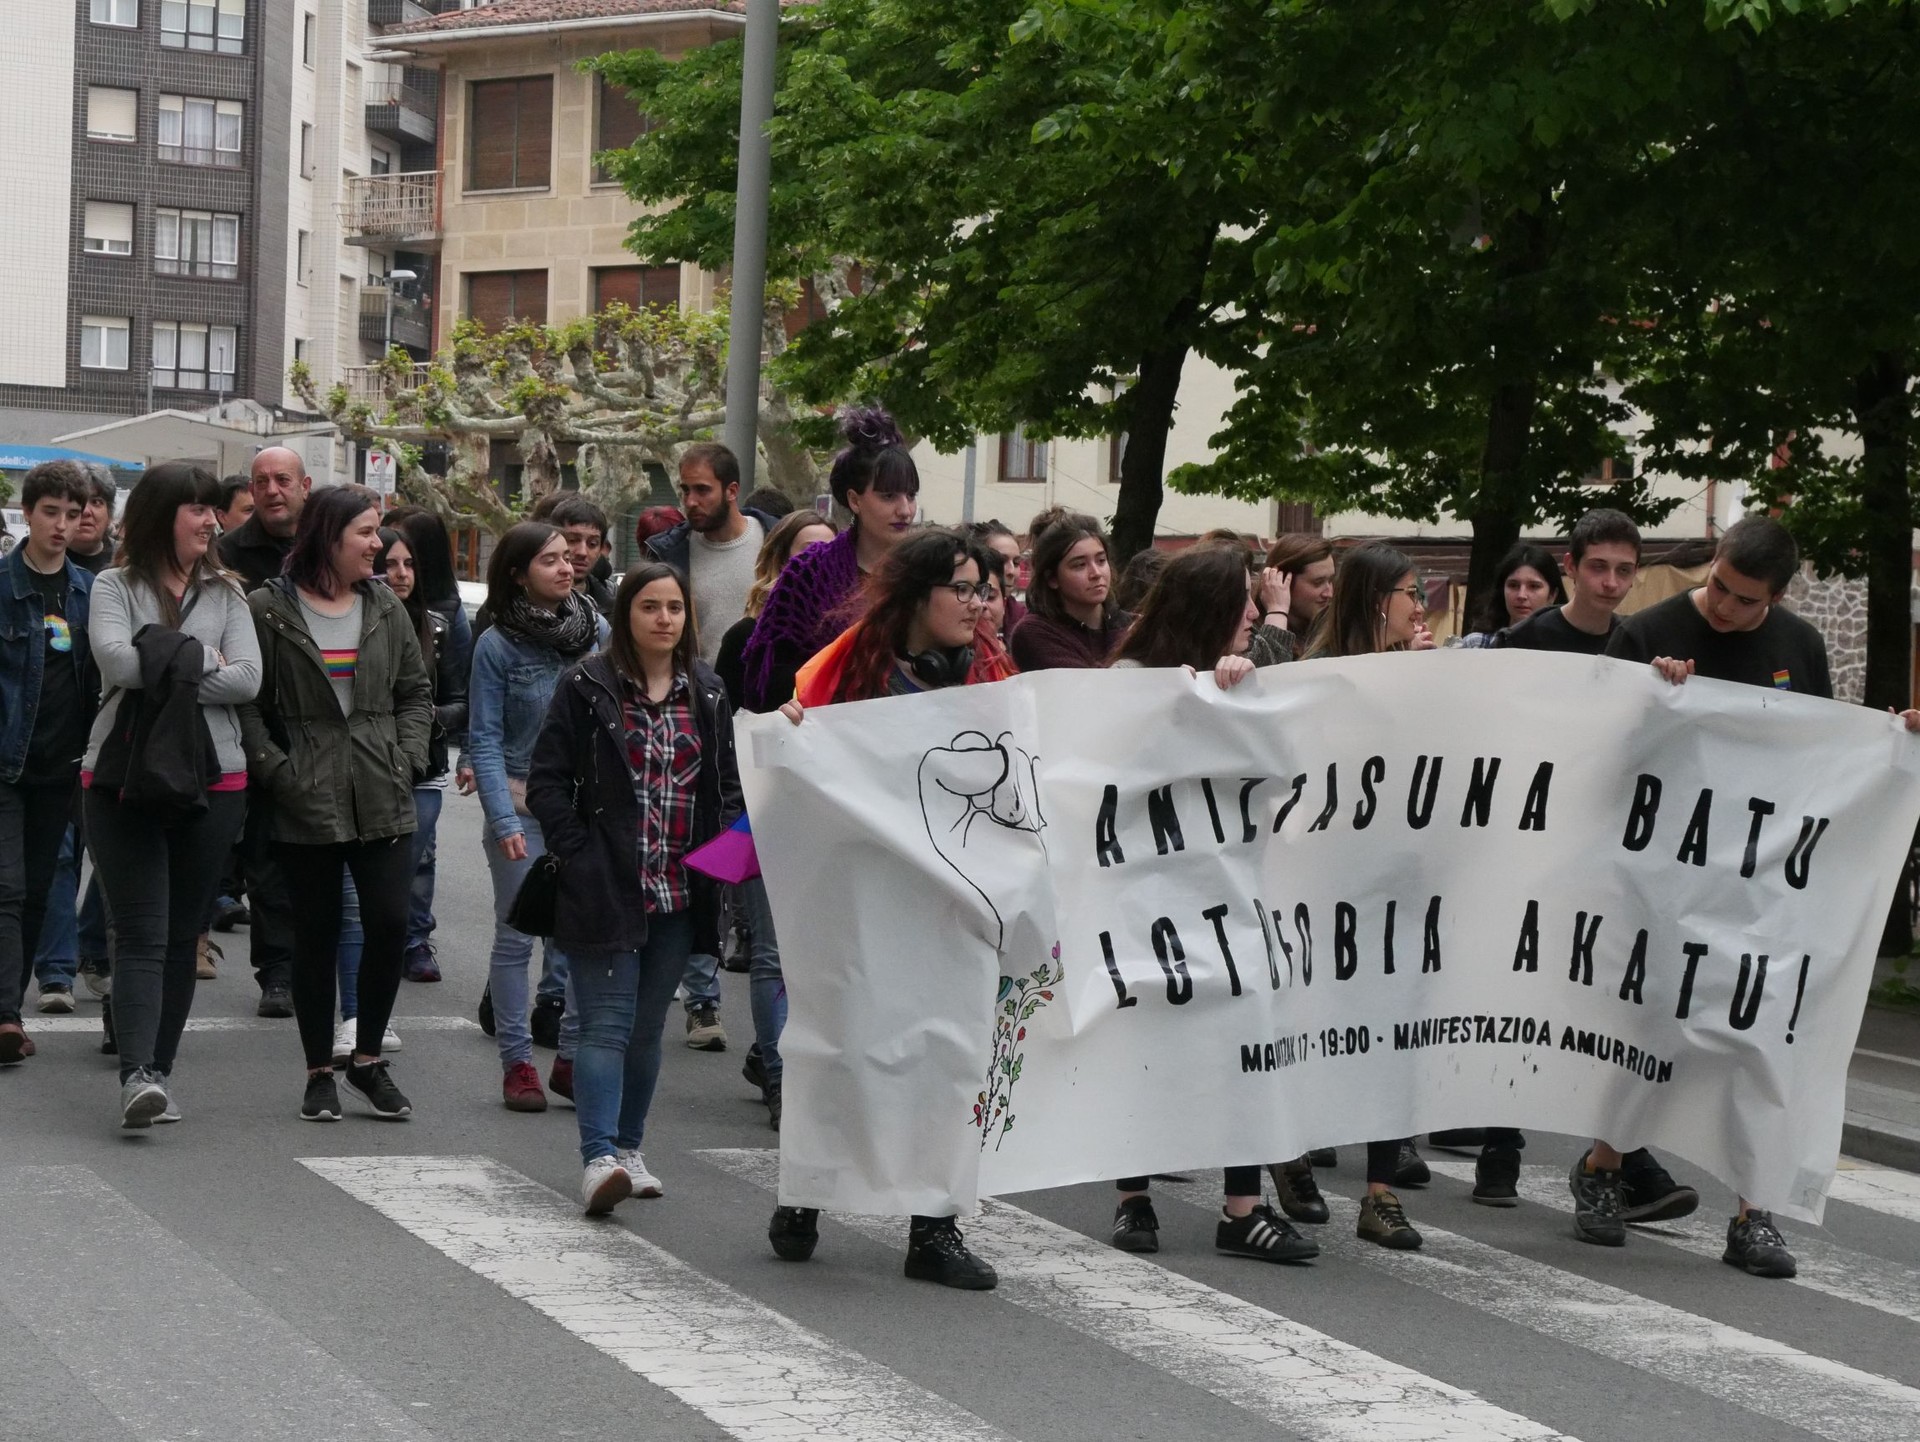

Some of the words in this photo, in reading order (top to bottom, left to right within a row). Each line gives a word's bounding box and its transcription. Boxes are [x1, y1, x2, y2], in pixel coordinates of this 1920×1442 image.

[1621, 773, 1830, 890] BATU
[1512, 899, 1811, 1045] AKATU!
[1319, 1025, 1370, 1058] 19:00
[1393, 1015, 1552, 1051] MANIFESTAZIOA
[1559, 1025, 1673, 1084] AMURRION
